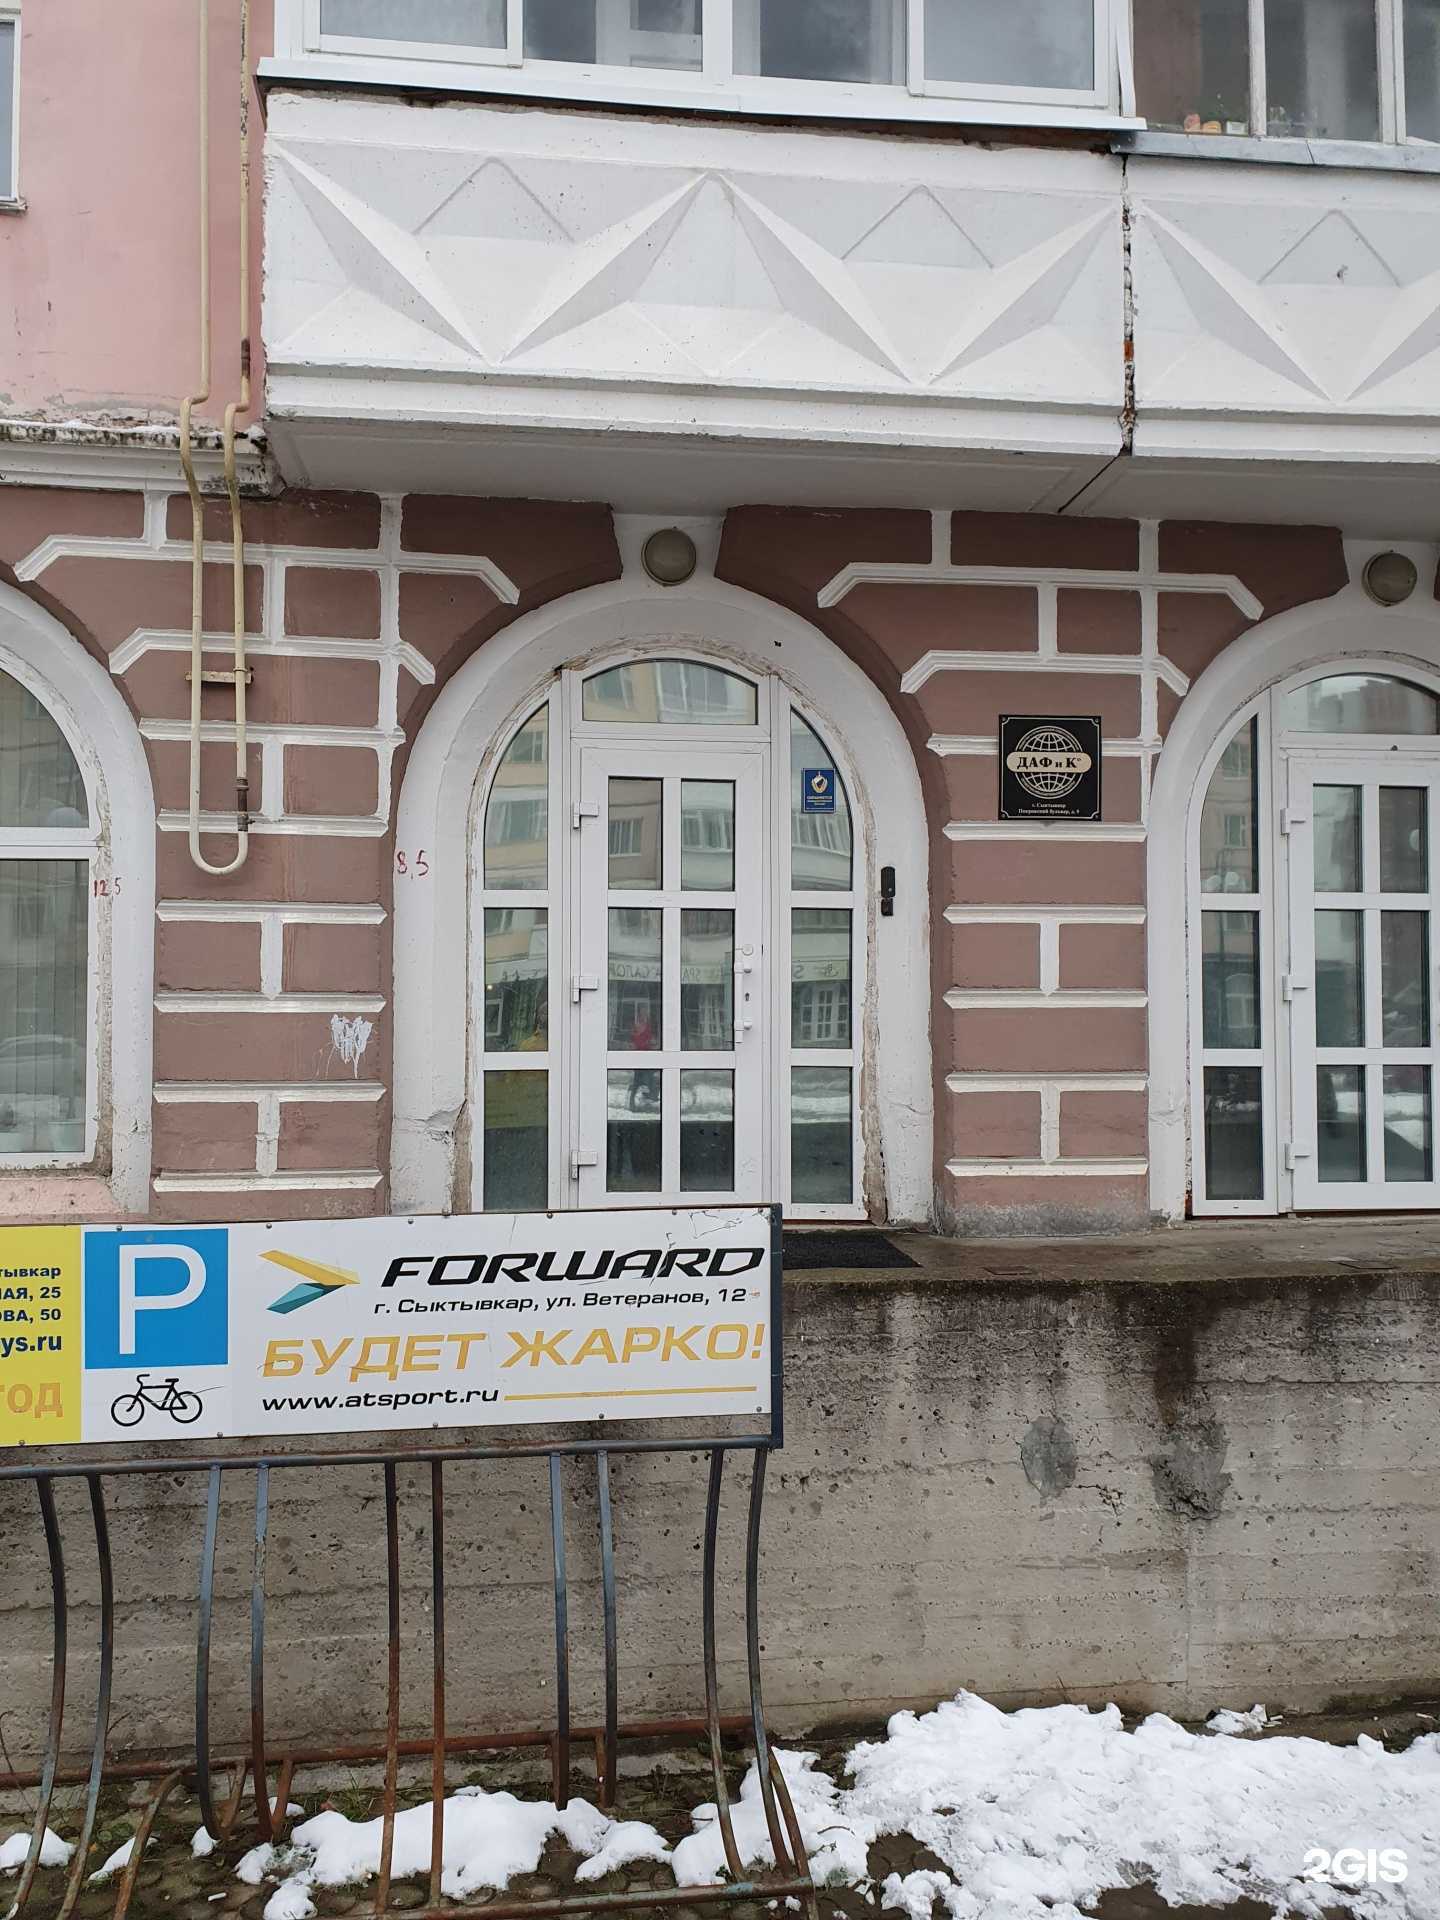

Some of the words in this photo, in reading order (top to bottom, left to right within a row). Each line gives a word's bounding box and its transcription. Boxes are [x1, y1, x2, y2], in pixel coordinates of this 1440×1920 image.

[1017, 757, 1052, 769] ДАФ
[381, 1247, 765, 1288] FORWARD
[0, 1286, 34, 1302] АЯ,
[39, 1286, 61, 1299] 25
[119, 1244, 207, 1355] P
[374, 1303, 391, 1314] г.
[398, 1297, 539, 1313] Сыктывкар,
[546, 1297, 577, 1312] ул.
[583, 1292, 710, 1308] Ветеранов,
[0, 1309, 34, 1324] ВА,
[40, 1308, 61, 1321] 50
[263, 1332, 486, 1383] БУДЕТ
[500, 1323, 766, 1368] ЖАРКО!
[262, 1389, 499, 1411] www.atsport.ru
